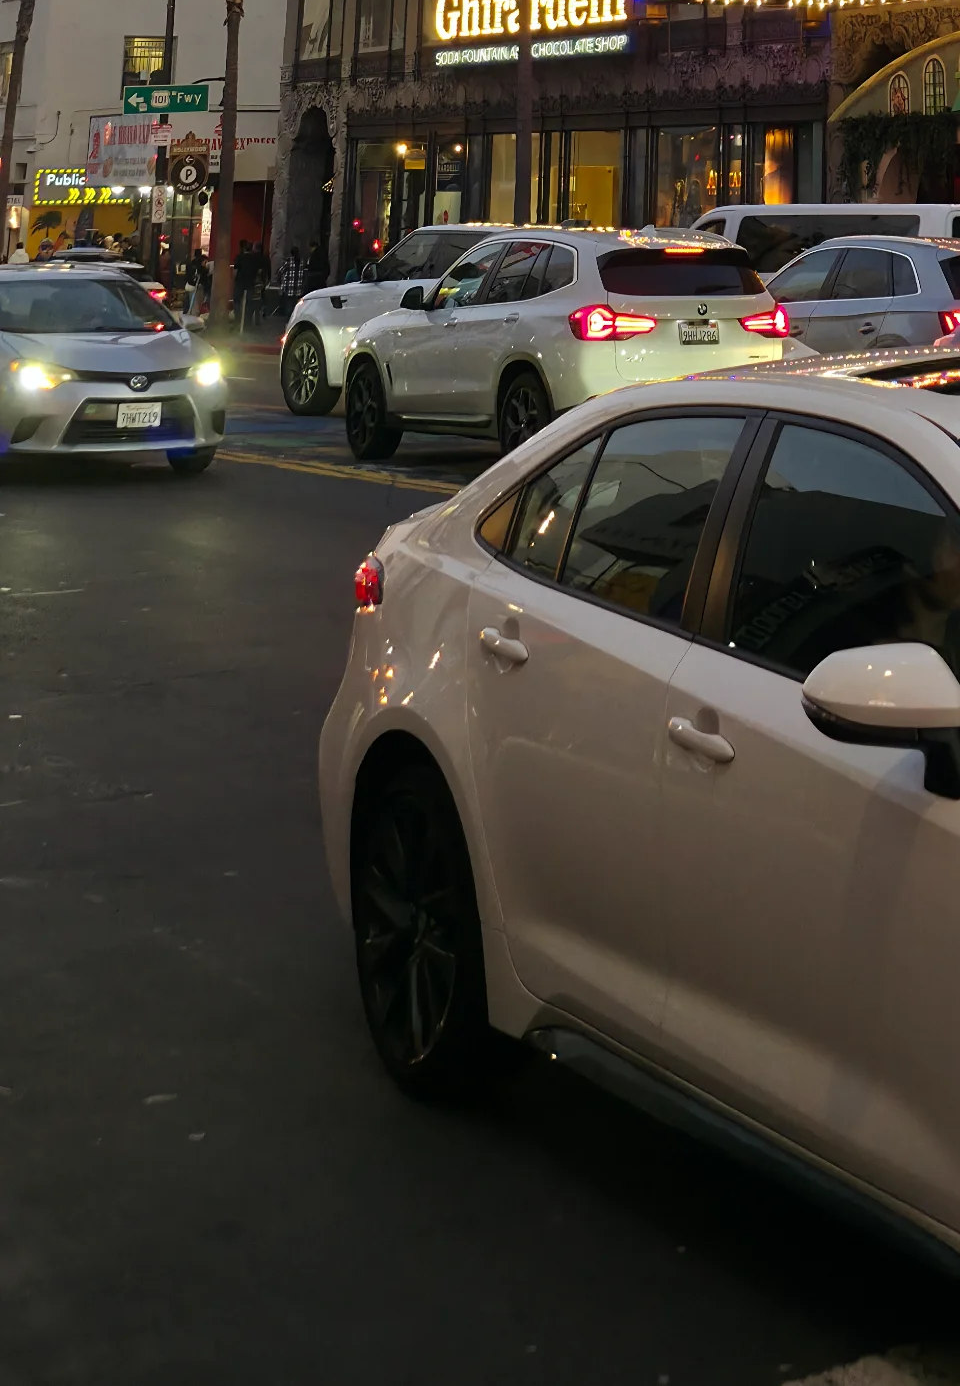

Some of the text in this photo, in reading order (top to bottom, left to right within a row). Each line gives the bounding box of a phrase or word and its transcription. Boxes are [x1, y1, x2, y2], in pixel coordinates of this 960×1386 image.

[435, 50, 460, 66] SODA
[461, 46, 508, 63] FOUNTAIN
[531, 38, 594, 58] CHOCOLATE
[594, 34, 628, 53] SHOP
[154, 92, 202, 106] 101 Fwy
[46, 173, 86, 186] Public
[177, 182, 199, 191] PARKING
[121, 411, 159, 425] 7HWT219
